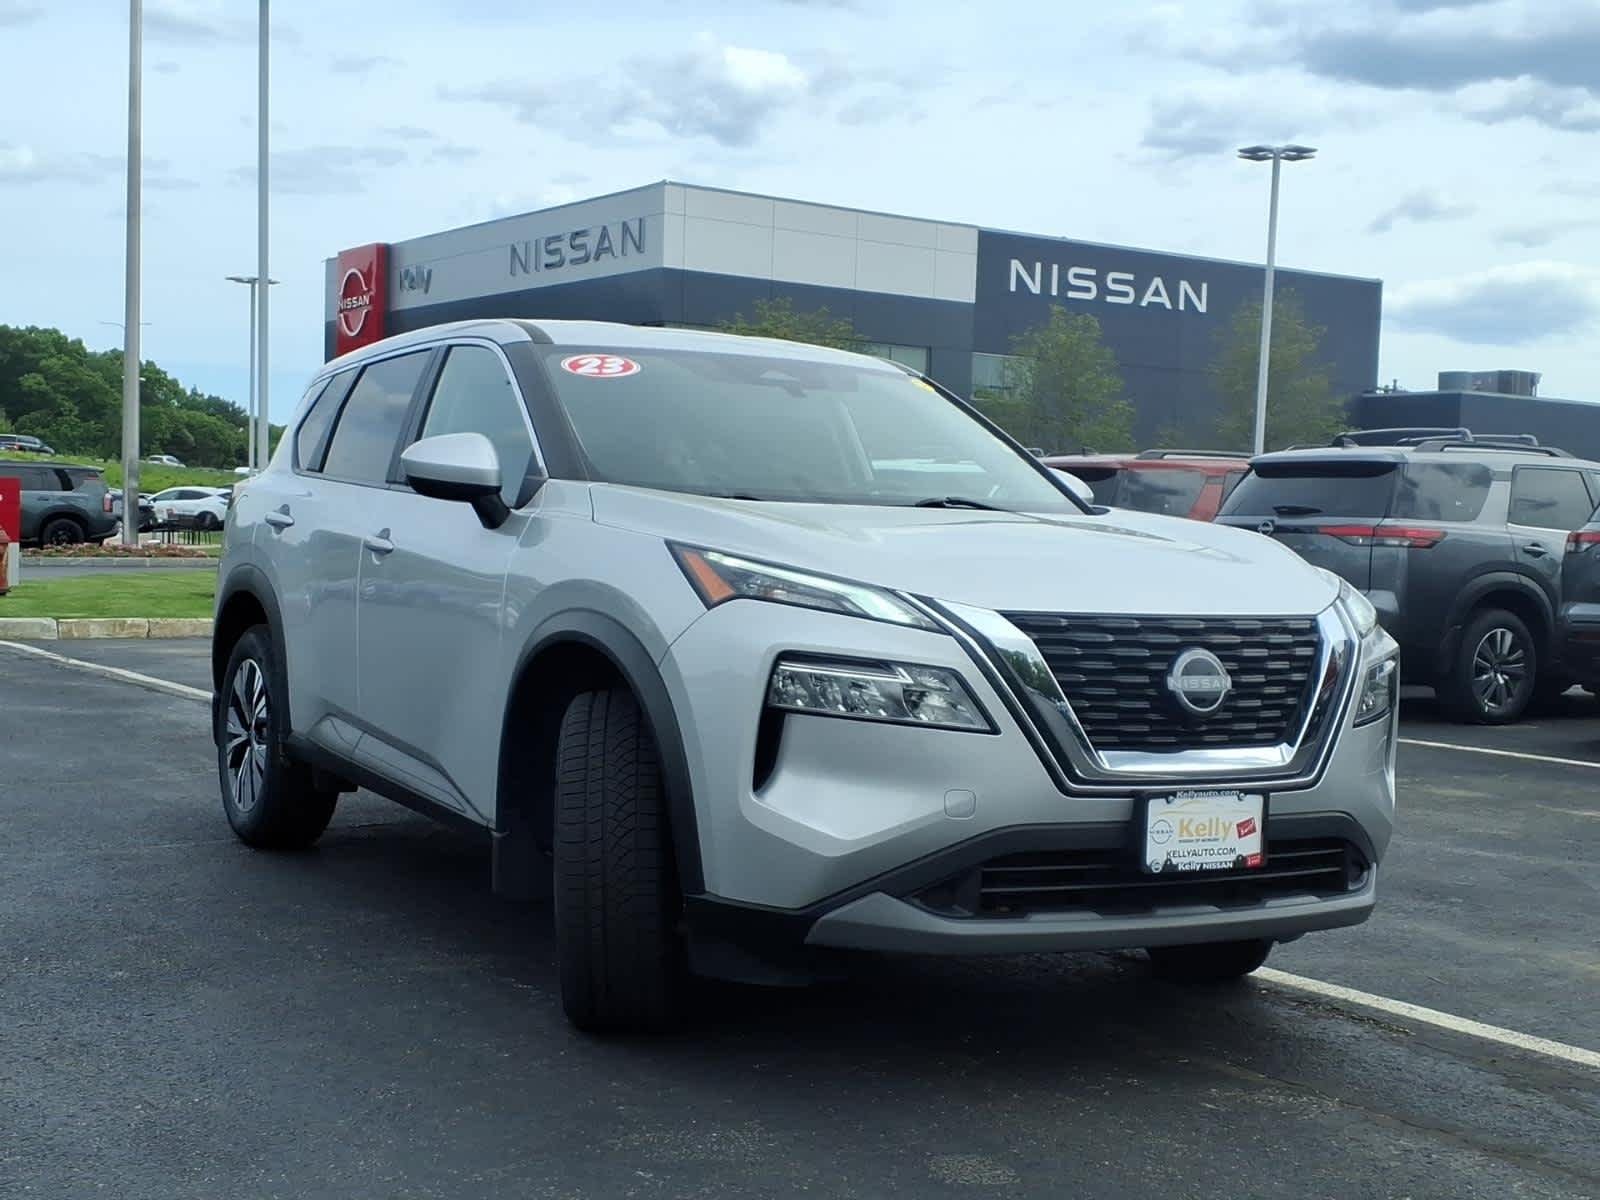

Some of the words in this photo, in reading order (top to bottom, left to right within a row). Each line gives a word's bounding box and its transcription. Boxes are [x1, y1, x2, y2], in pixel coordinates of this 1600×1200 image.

[510, 217, 646, 276] NISSAN
[1009, 258, 1208, 313] NISSAN
[338, 295, 370, 310] NISSAN
[576, 356, 626, 375] 23
[1168, 678, 1231, 689] NISSAN
[1179, 817, 1232, 841] Kelly
[1166, 848, 1237, 858] KELLYAUTO.COM
[1178, 861, 1201, 871] Kelly
[1203, 860, 1233, 869] NISSAN
